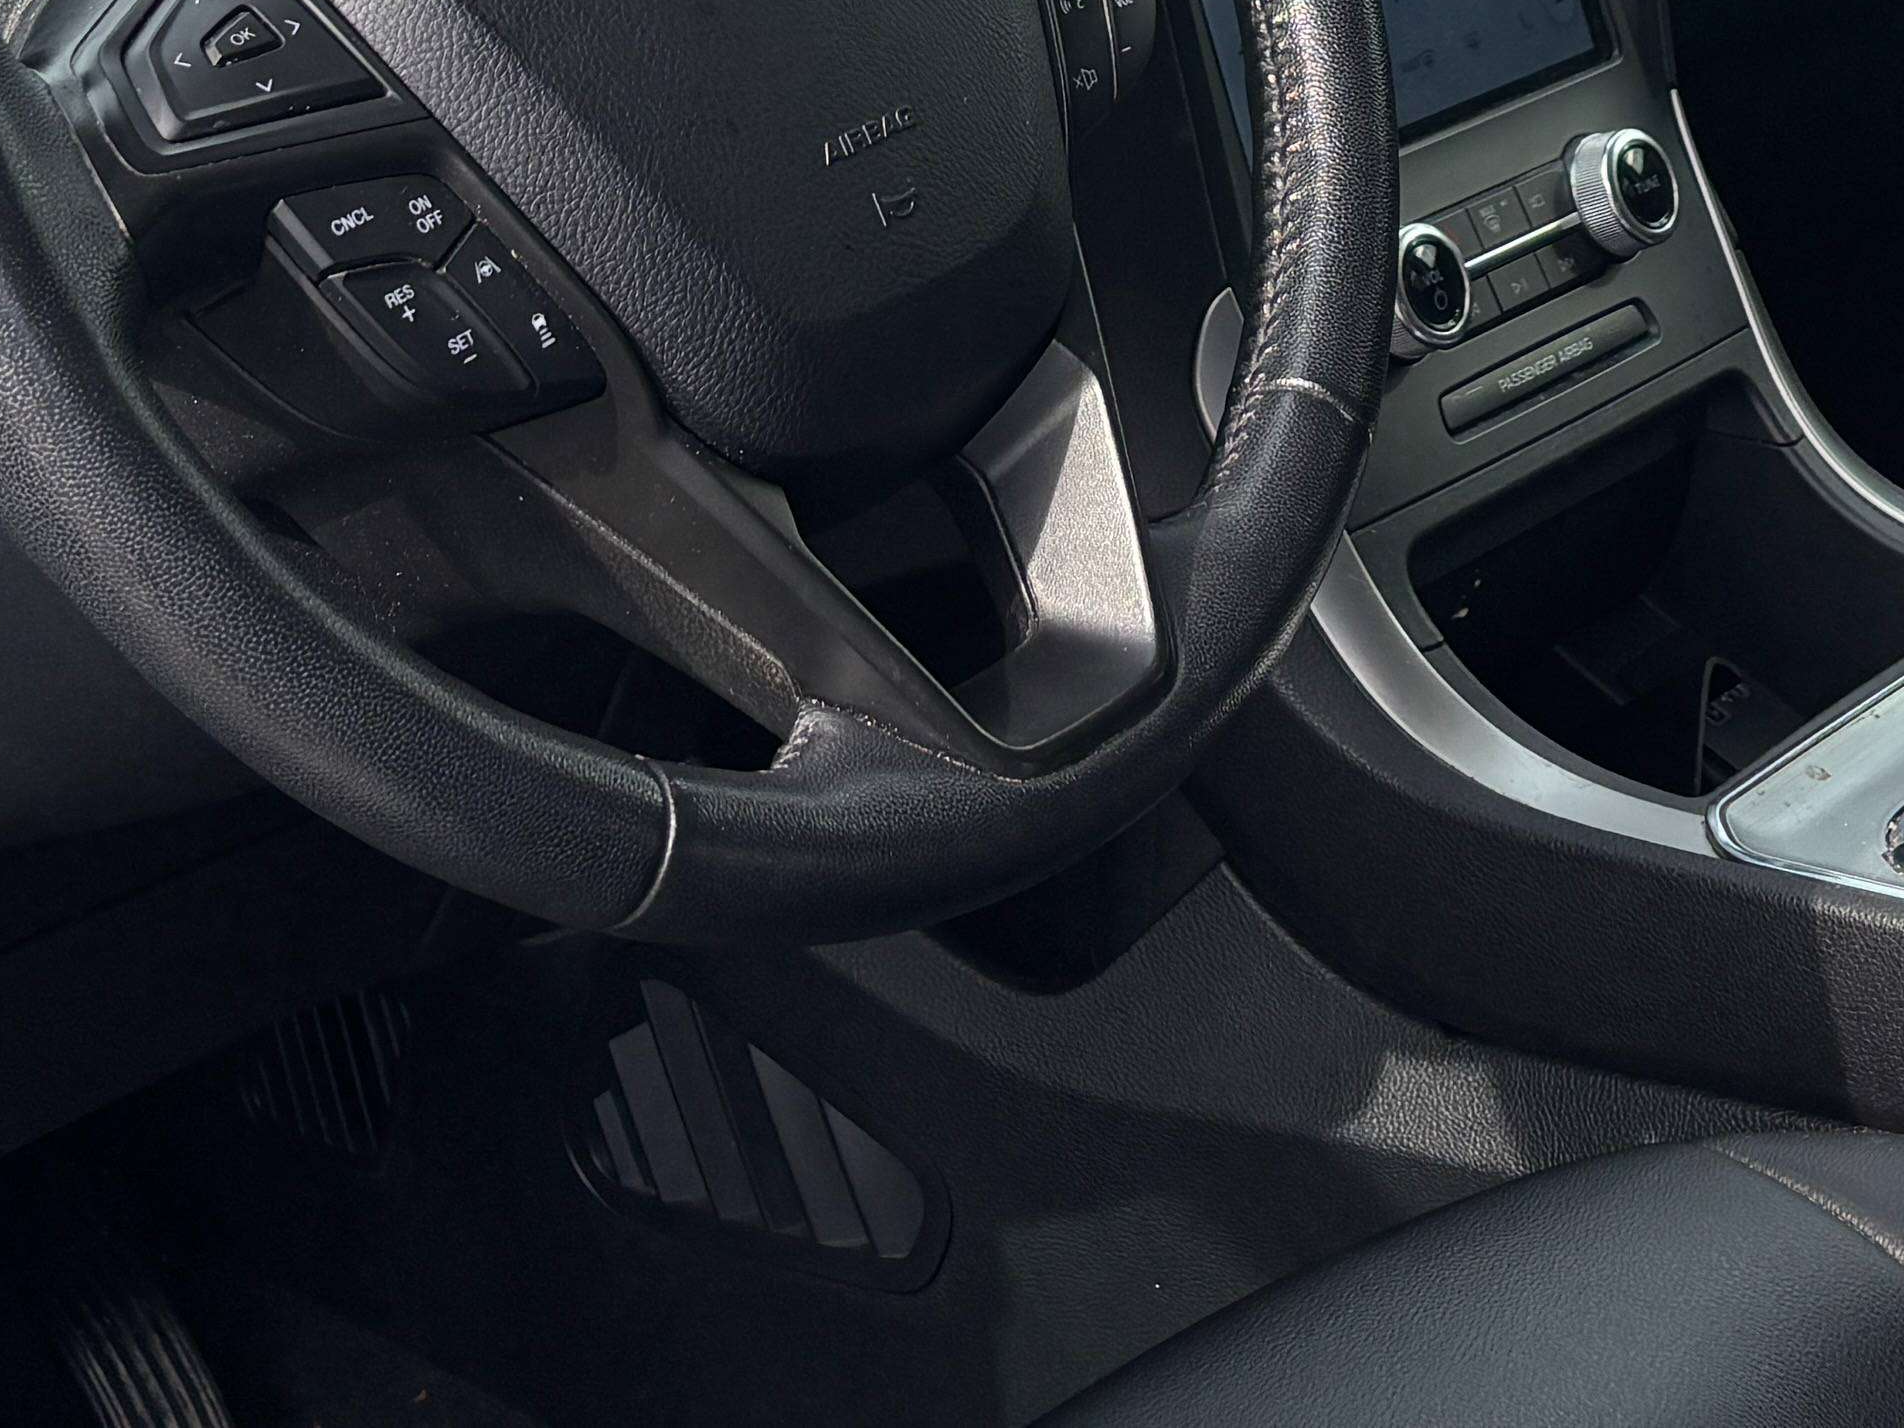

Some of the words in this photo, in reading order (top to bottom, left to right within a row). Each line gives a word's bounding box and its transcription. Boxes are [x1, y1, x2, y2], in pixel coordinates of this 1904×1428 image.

[230, 27, 257, 46] OK
[824, 104, 916, 167] AIRBAG
[408, 195, 433, 216] ON
[330, 206, 375, 236] CNCL
[416, 210, 444, 234] OFF
[384, 284, 416, 310] RES
[447, 329, 476, 355] SET
